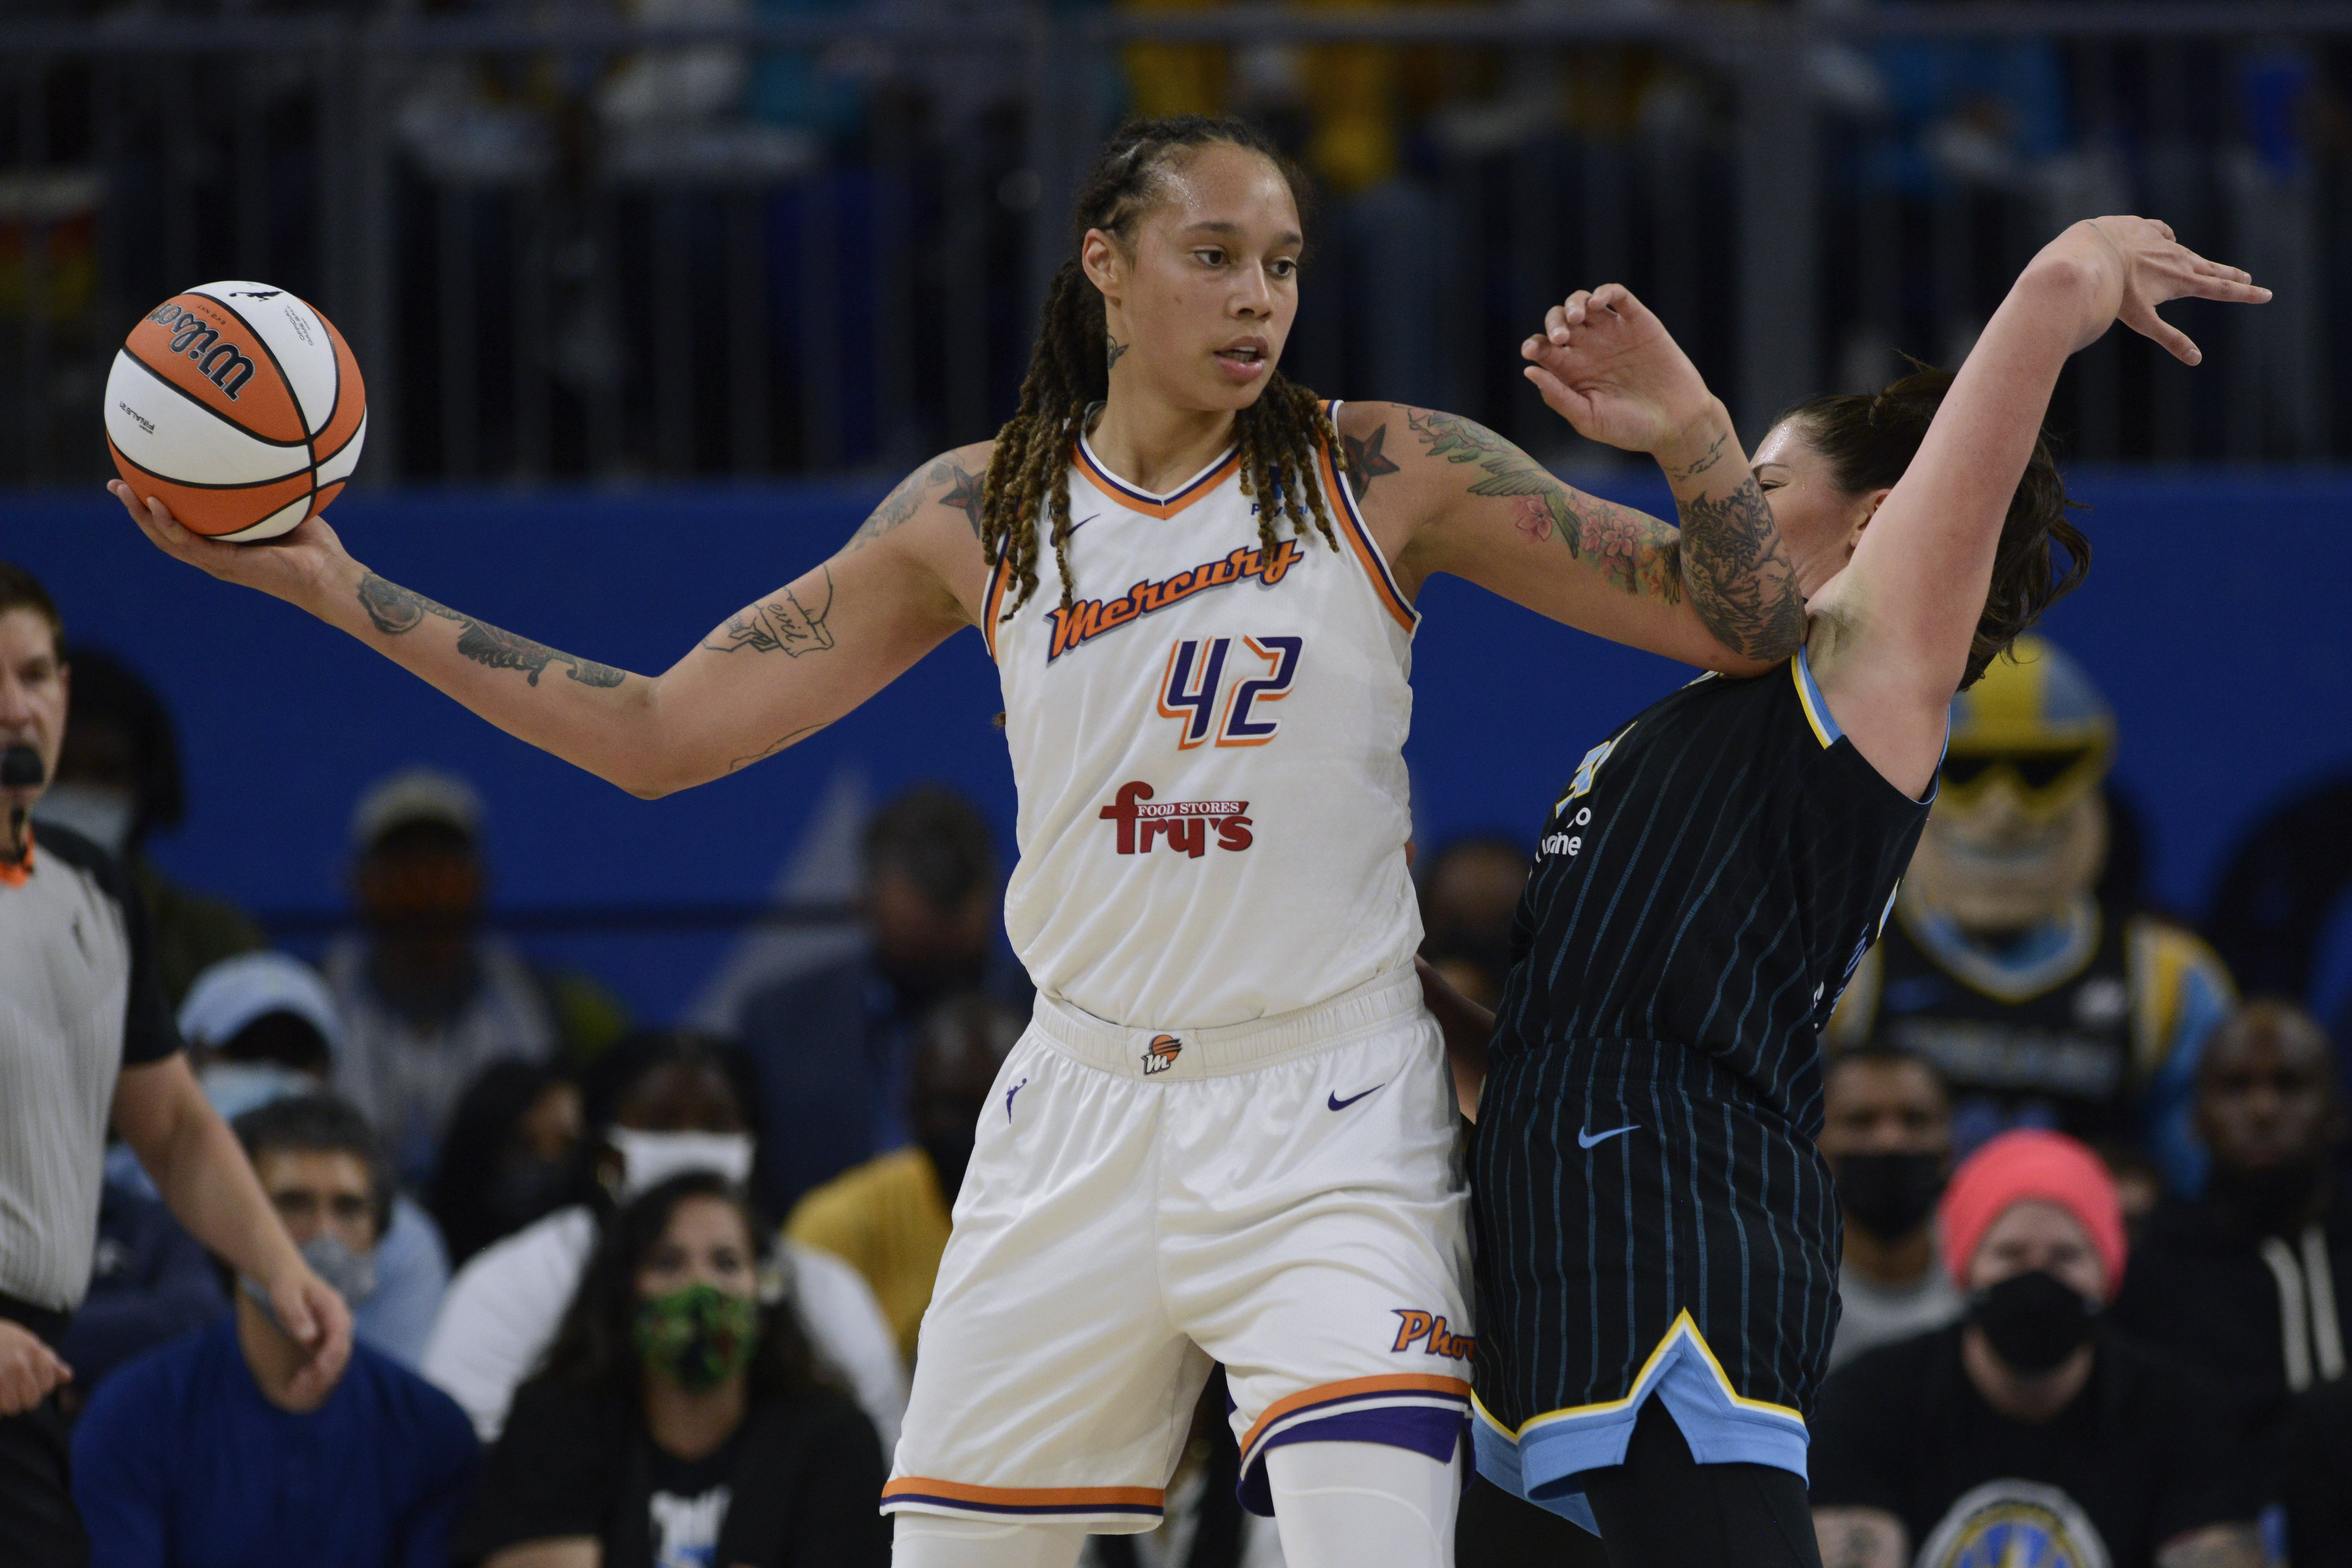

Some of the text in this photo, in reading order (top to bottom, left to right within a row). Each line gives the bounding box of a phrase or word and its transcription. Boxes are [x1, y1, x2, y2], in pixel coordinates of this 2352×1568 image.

[284, 309, 304, 340] OFFICIAL
[298, 323, 313, 346] GAME
[127, 407, 154, 430] FINALS
[1043, 539, 1304, 668] Mercury
[1157, 635, 1306, 750] 42
[1099, 781, 1253, 859] fry's
[1137, 802, 1240, 816] FOOD STORES
